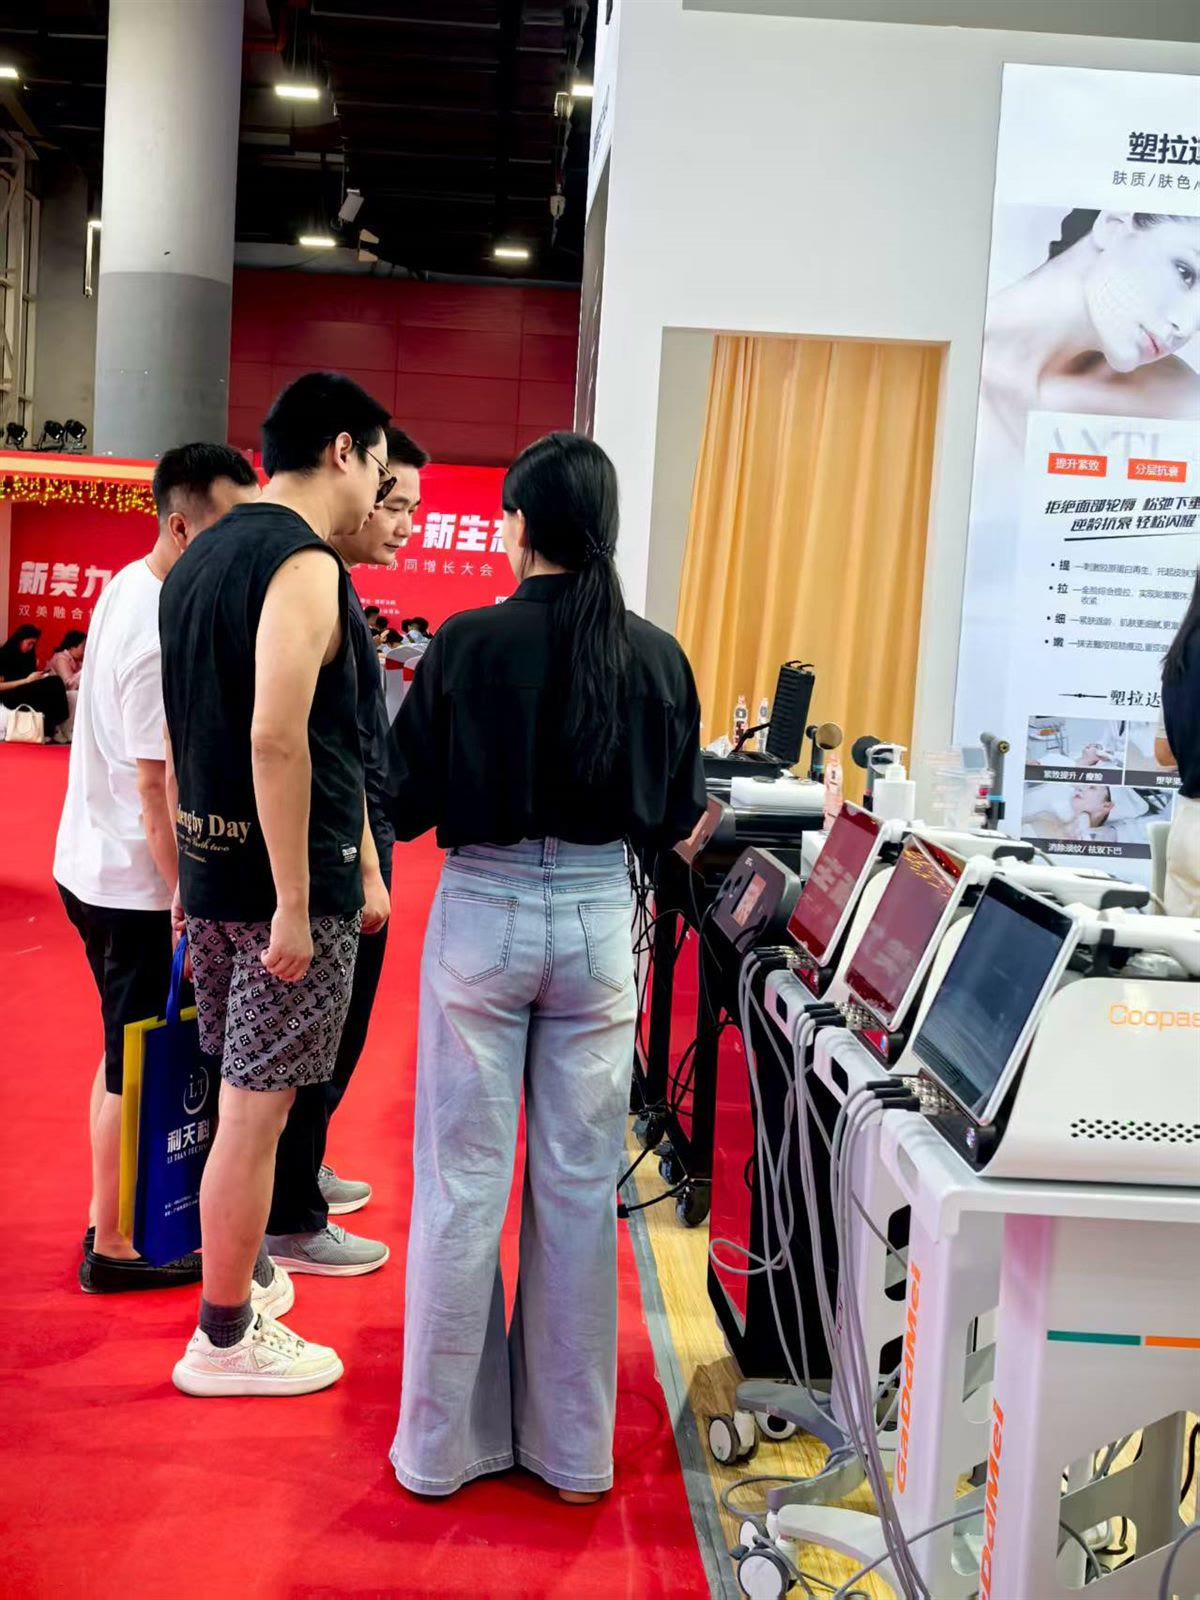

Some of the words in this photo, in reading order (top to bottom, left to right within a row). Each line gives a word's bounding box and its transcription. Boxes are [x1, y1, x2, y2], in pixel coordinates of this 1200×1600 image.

[1055, 457, 1100, 472] 提升紧致
[1044, 498, 1138, 515] 拒绝面部轮廓
[1070, 516, 1133, 532] 逆龄抗衰
[1136, 514, 1197, 529] 轻松闪耀
[1057, 583, 1069, 594] 拉
[18, 604, 93, 620] 双美融合
[208, 814, 251, 843] Day
